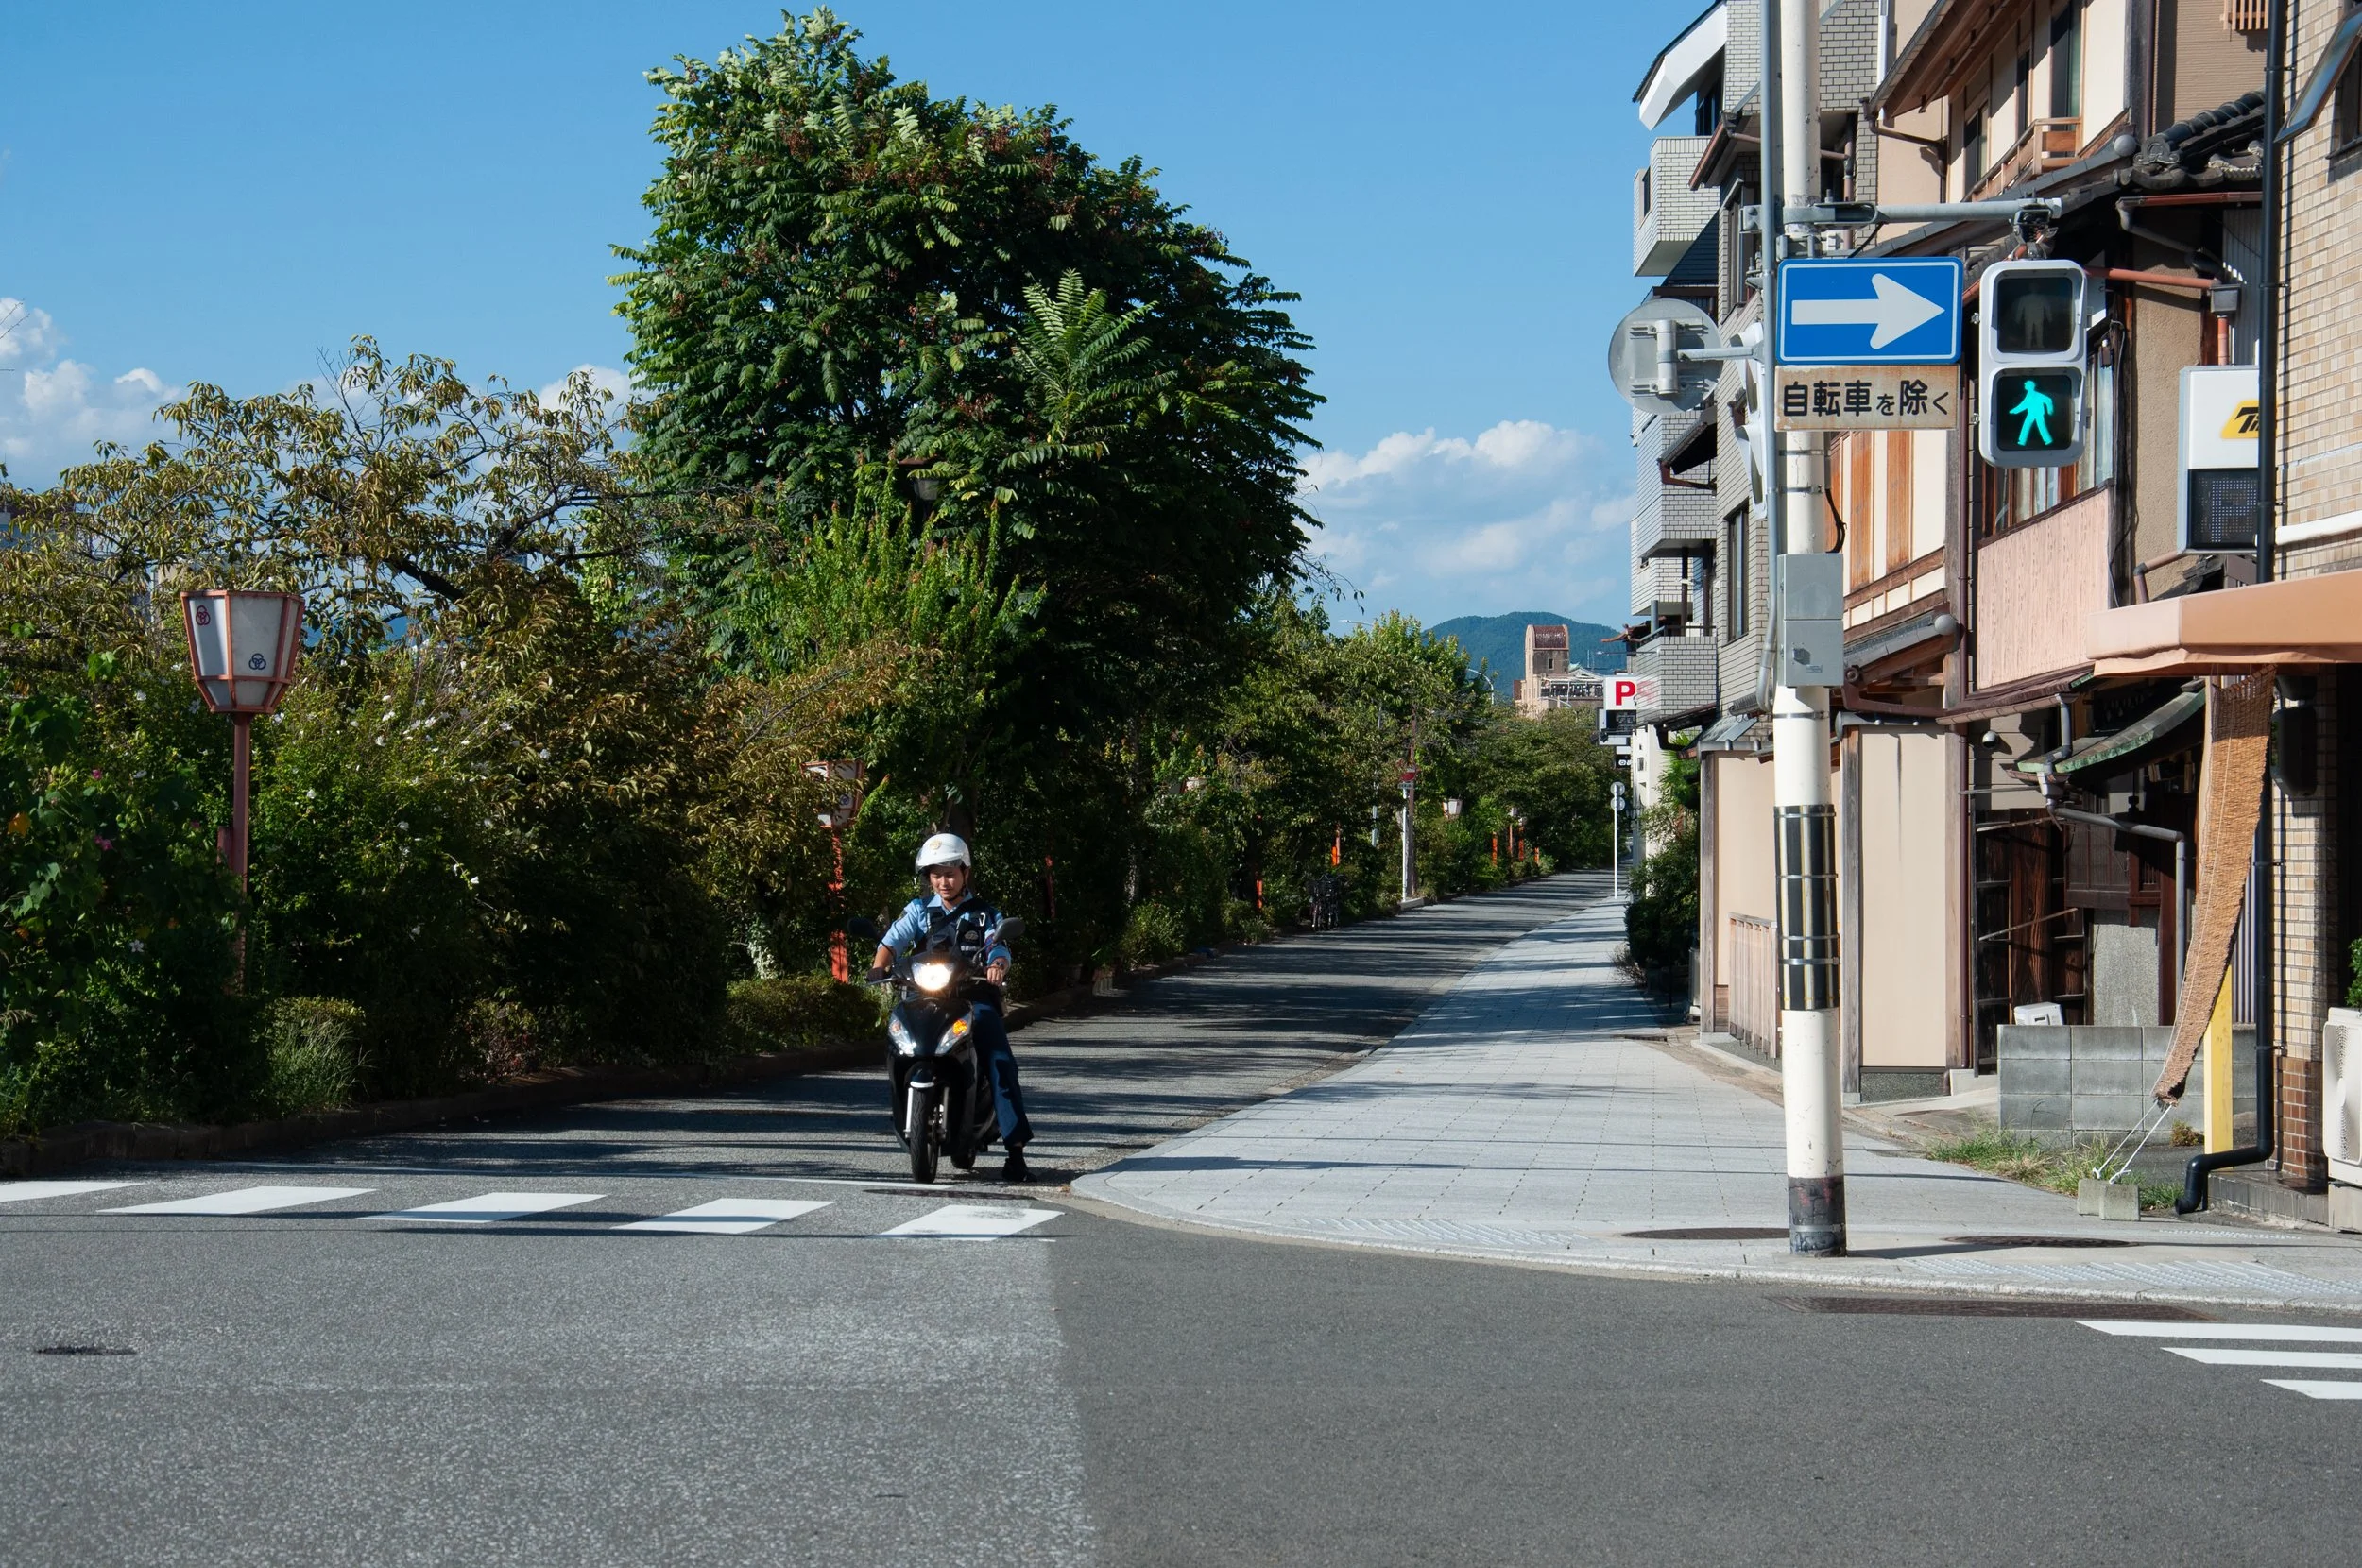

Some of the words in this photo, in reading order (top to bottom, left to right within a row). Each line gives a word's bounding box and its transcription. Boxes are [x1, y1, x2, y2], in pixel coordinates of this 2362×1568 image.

[1783, 379, 1949, 417] 自転車を除く
[1615, 681, 1636, 706] P
